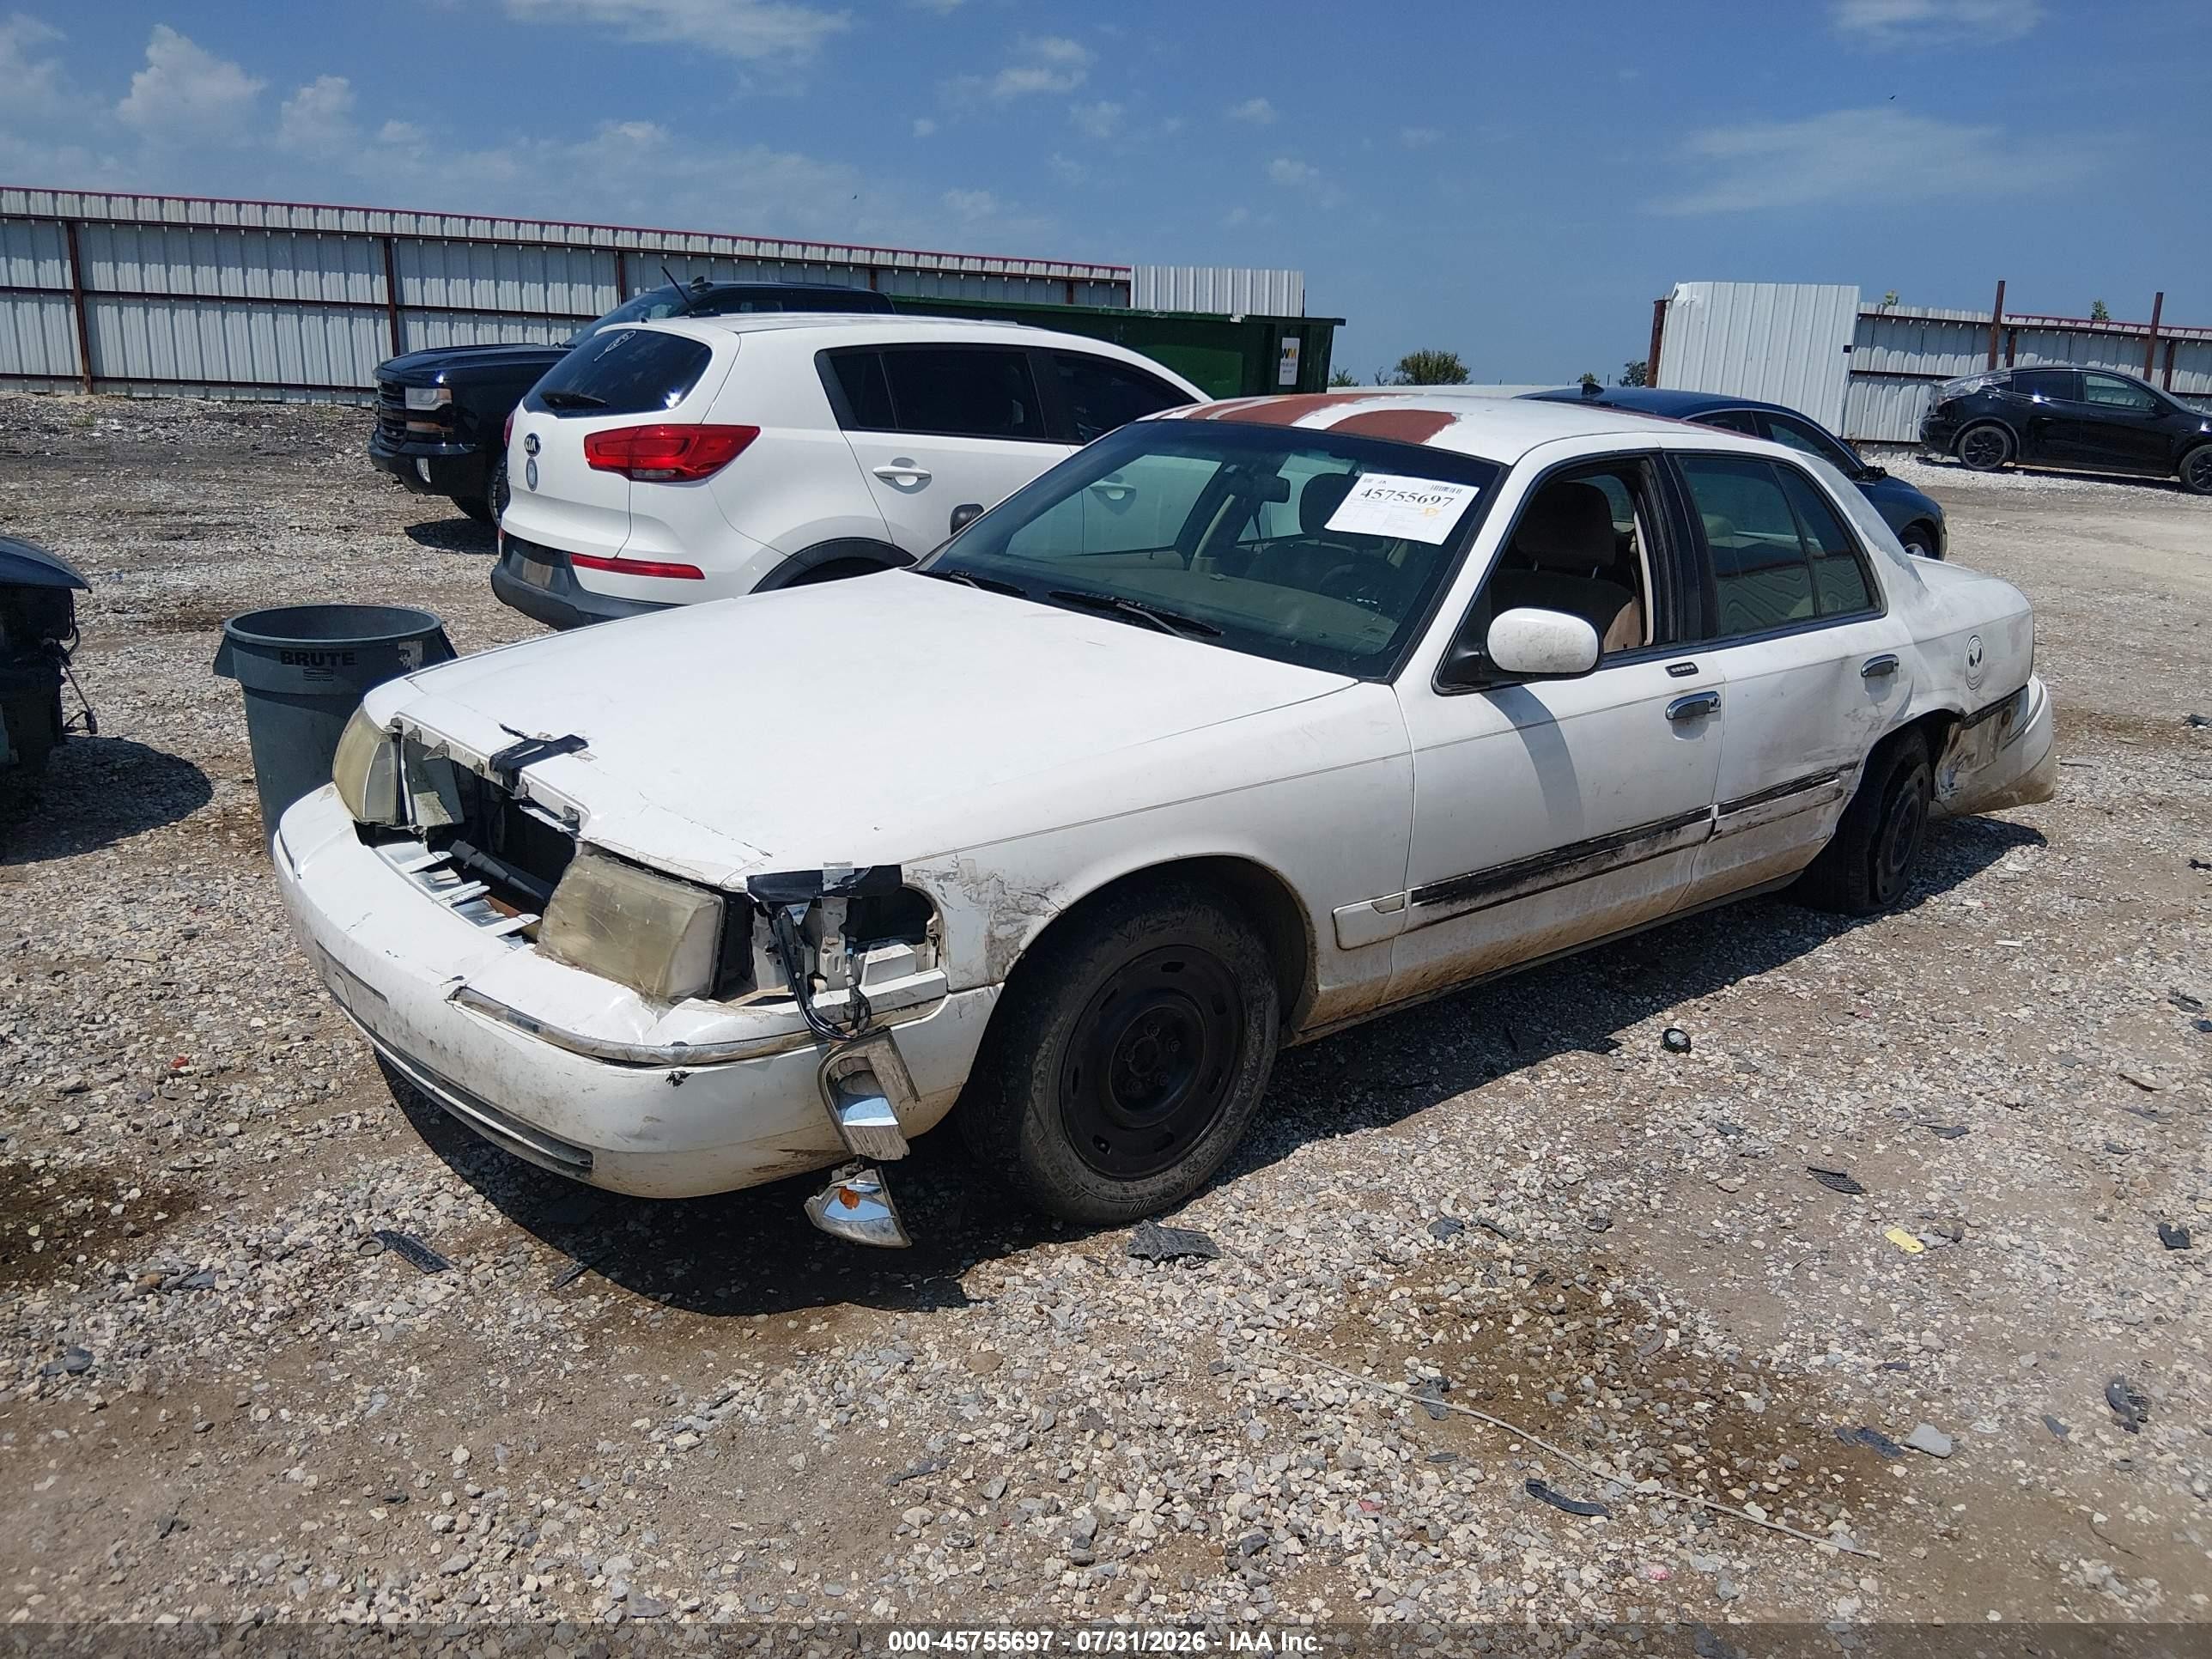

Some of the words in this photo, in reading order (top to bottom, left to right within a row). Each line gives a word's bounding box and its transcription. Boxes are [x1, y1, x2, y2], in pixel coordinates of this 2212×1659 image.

[525, 436, 537, 452] KIA
[1359, 487, 1455, 507] 45755697
[279, 650, 358, 667] BRUTE
